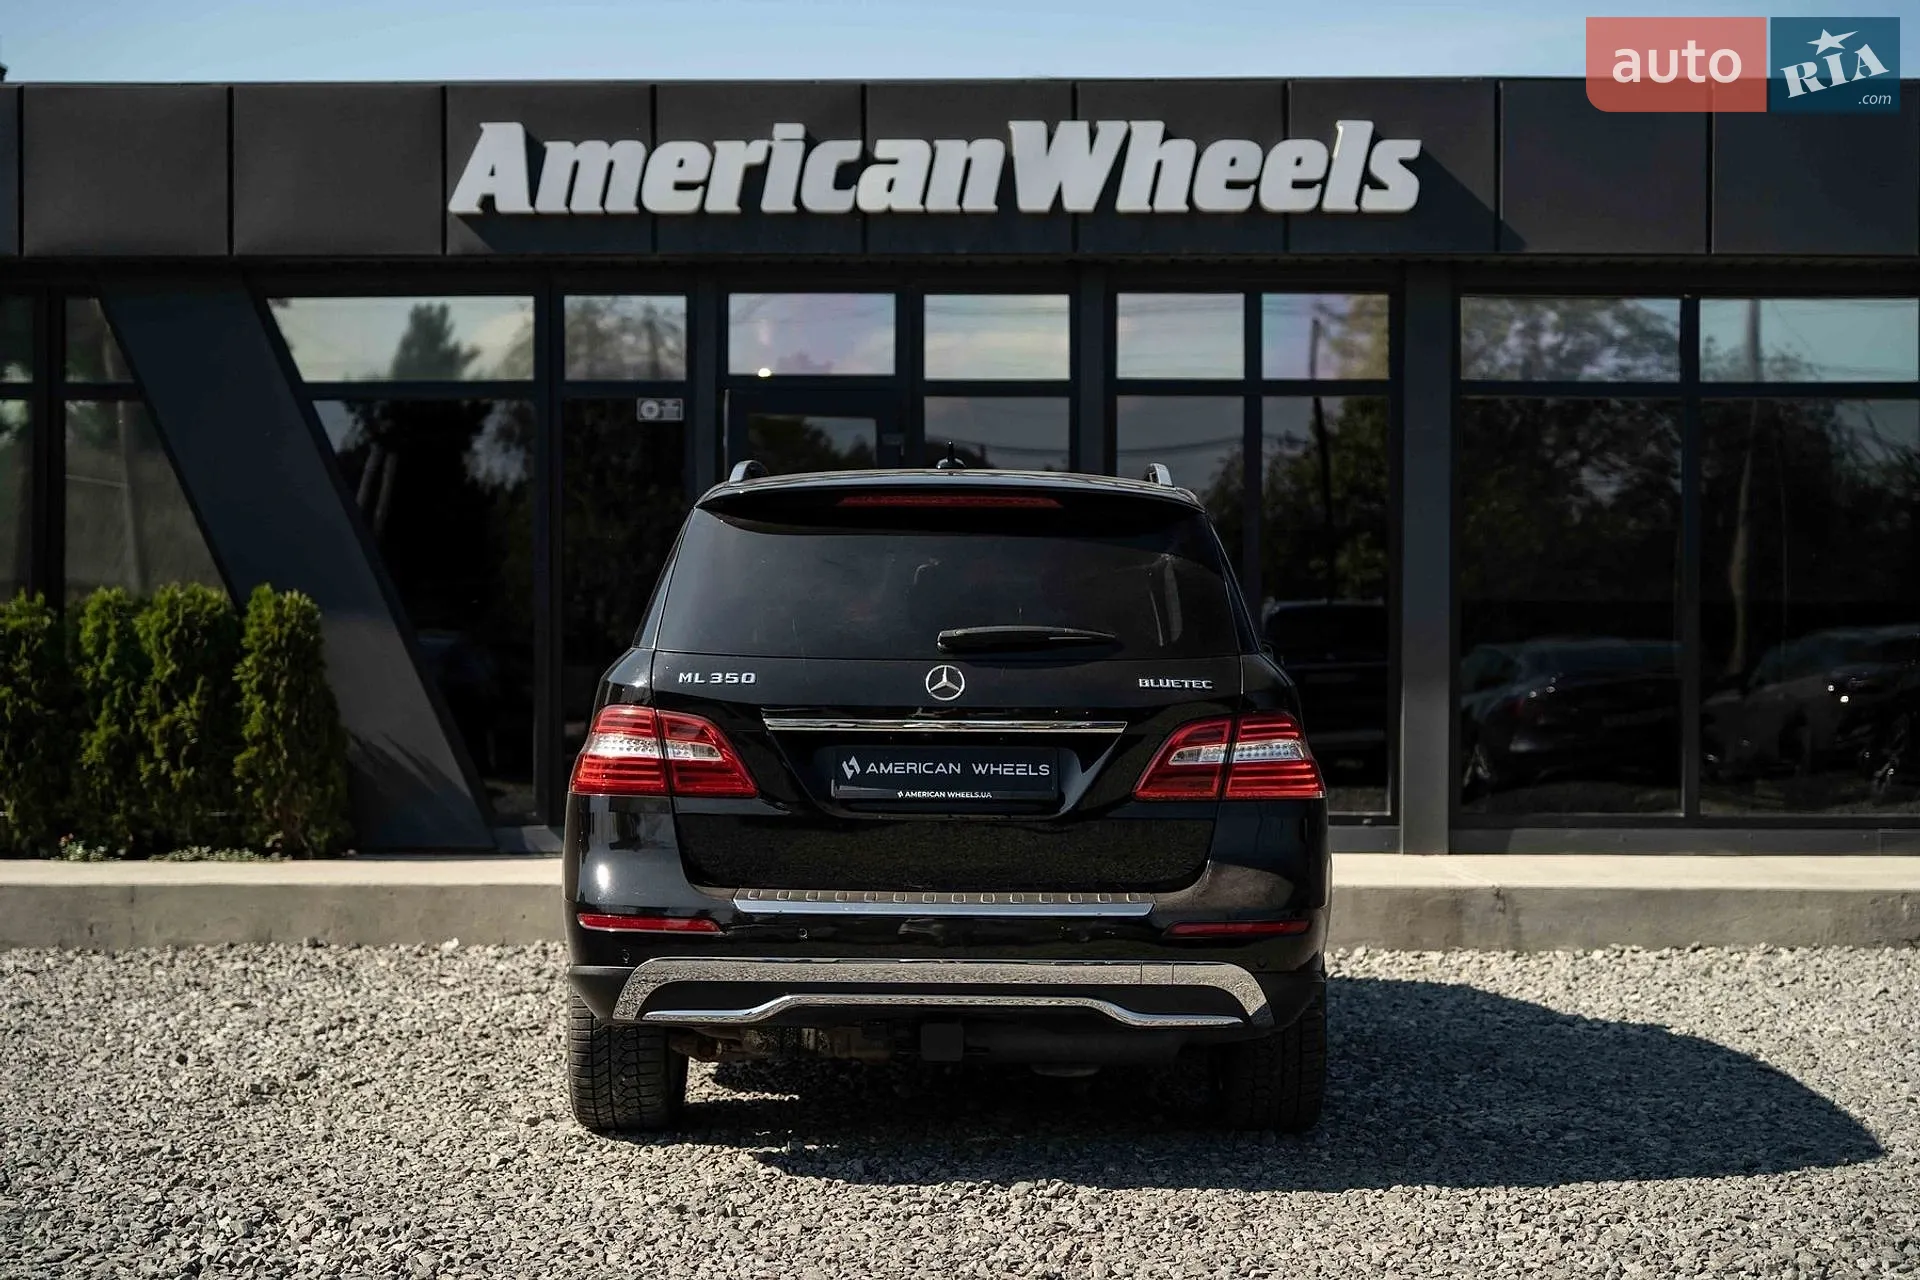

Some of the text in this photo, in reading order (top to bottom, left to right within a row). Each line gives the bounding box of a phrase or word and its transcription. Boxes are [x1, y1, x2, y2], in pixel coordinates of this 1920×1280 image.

[447, 119, 1422, 215] AmericanWheels
[678, 672, 756, 684] ML 350
[1138, 678, 1213, 689] BLUETEC
[865, 762, 1050, 776] AMERICAN WHEELS
